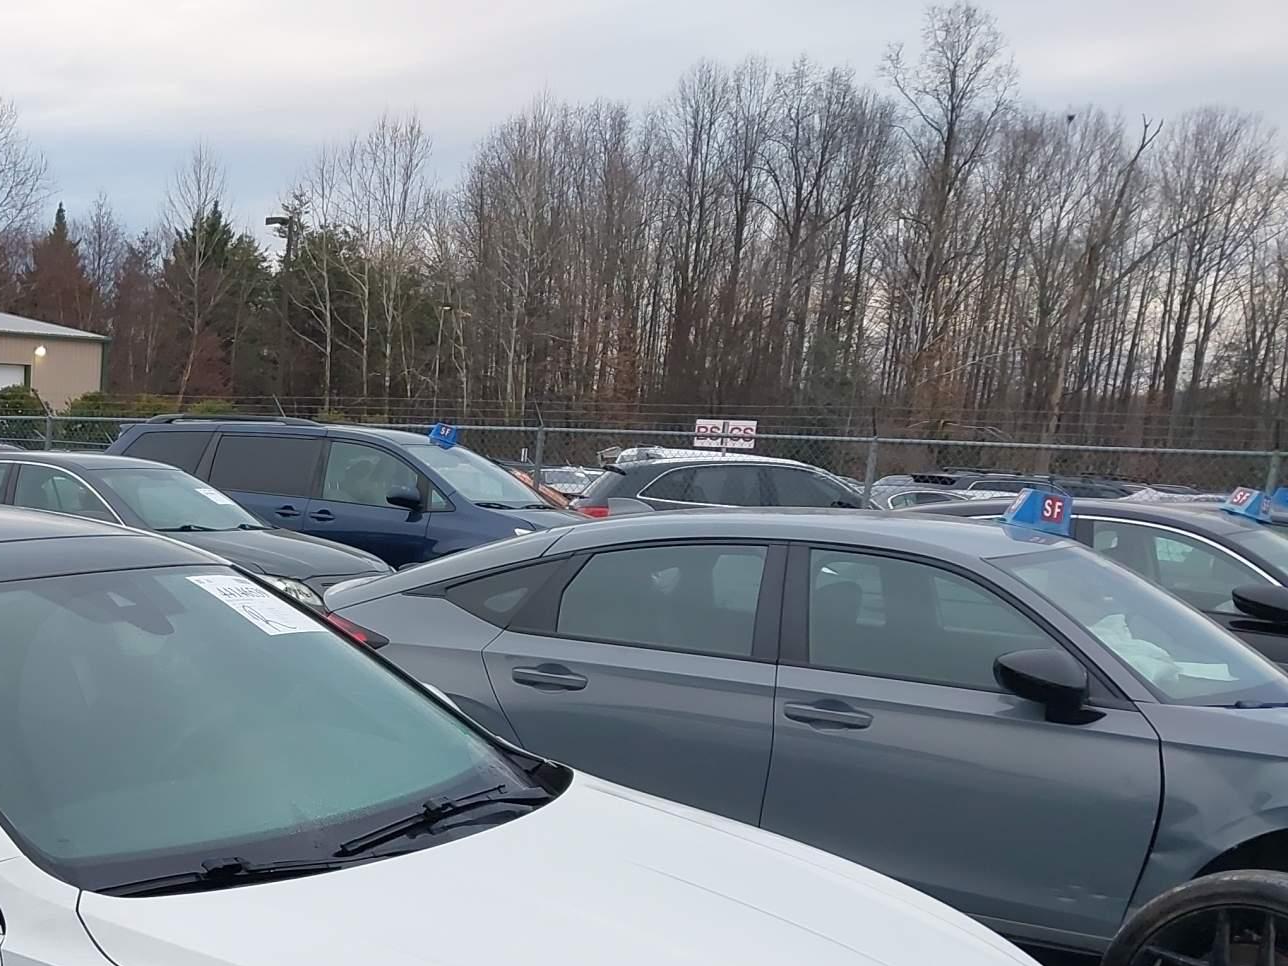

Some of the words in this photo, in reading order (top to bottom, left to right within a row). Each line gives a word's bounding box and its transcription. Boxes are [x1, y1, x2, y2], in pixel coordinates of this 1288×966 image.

[440, 427, 451, 437] SF
[1233, 491, 1251, 504] SF
[1043, 499, 1063, 519] SF
